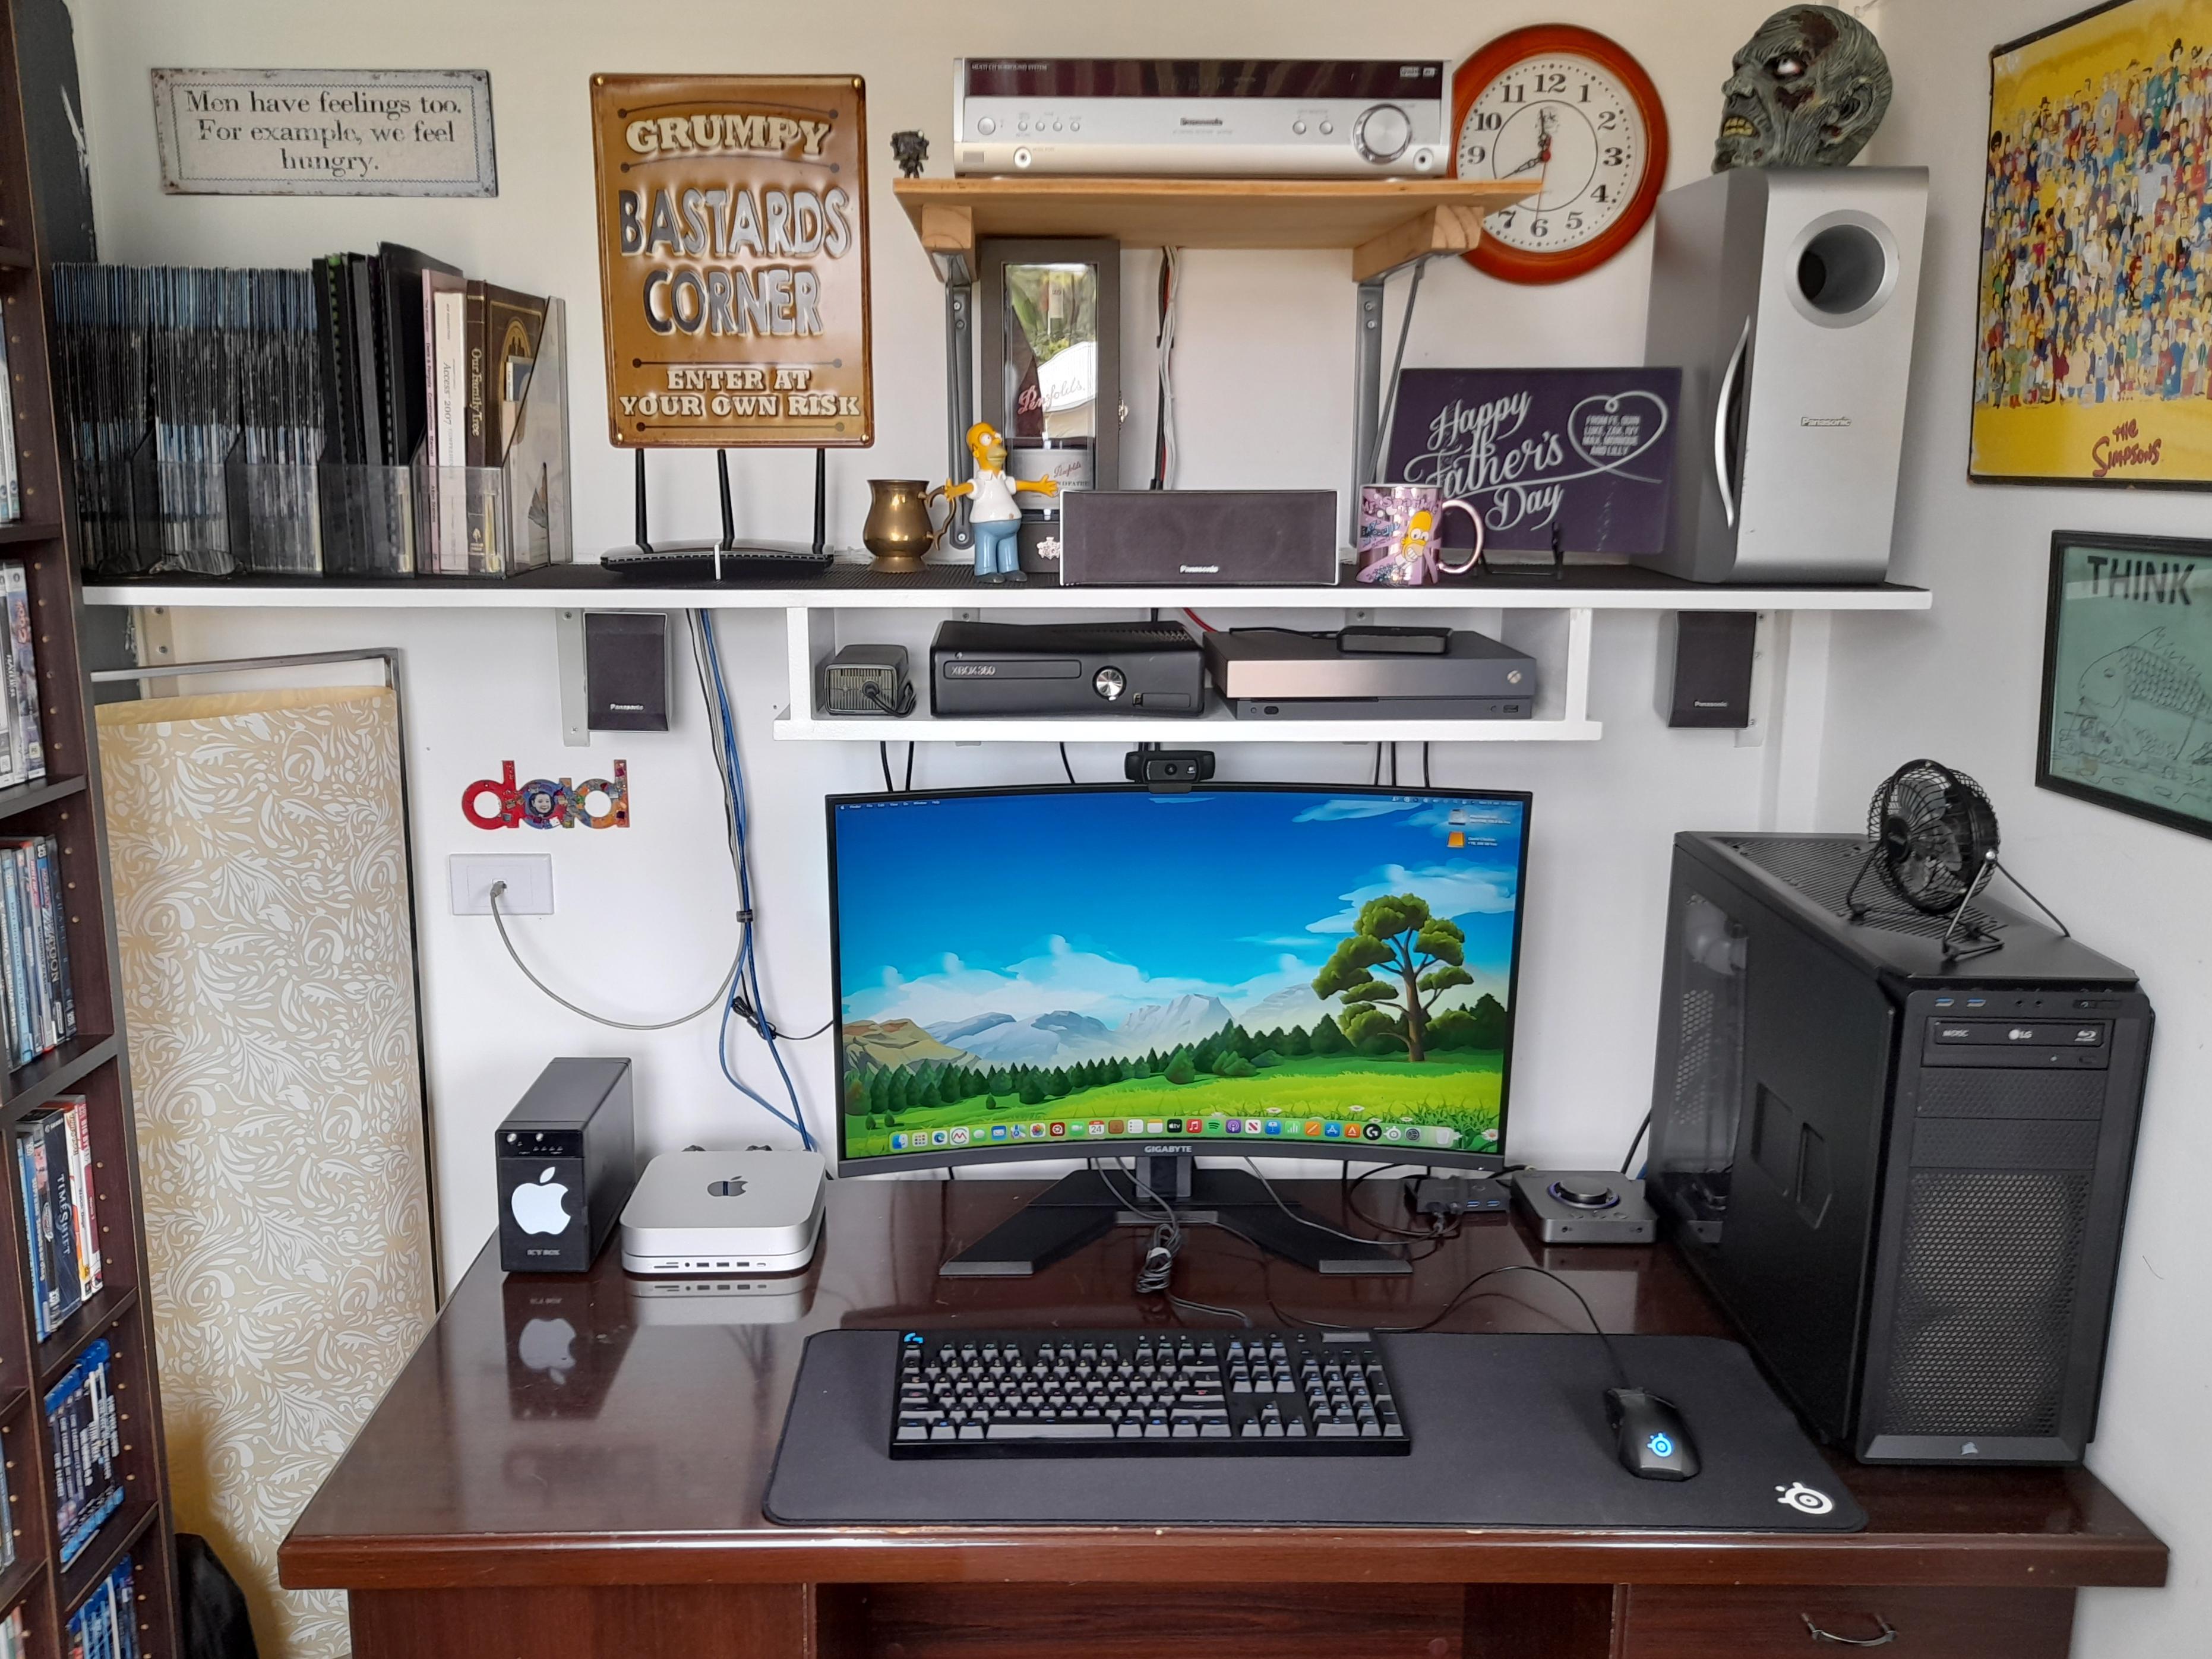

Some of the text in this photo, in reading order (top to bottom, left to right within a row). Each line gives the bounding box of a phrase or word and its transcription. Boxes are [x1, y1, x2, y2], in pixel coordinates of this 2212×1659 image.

[1501, 84, 1527, 103] 11
[1534, 74, 1567, 93] 12
[1579, 84, 1591, 103] 1
[185, 90, 462, 121] Men have feelings too.
[1474, 112, 1502, 131] 10
[1597, 111, 1617, 131] 2
[197, 119, 455, 148] For example, we feel
[625, 114, 832, 156] GRUMPY
[280, 148, 380, 177] hungry.
[1467, 146, 1485, 165] 9
[1604, 147, 1624, 166] 3
[1590, 184, 1609, 203] 4
[618, 188, 852, 258] BASTARDS
[1498, 210, 1516, 229] 7
[1531, 218, 1549, 238] 6
[1565, 211, 1584, 230] 5
[643, 268, 824, 337] CORNER
[666, 368, 811, 390] ENTER AT
[469, 348, 483, 437] Our Family Tree
[444, 401, 452, 426] 2007
[619, 395, 861, 418] YOUR OWN RISK
[1427, 391, 1532, 451] Happy
[1801, 416, 1851, 426] Panasonic
[1404, 429, 1565, 499] Father's
[1485, 484, 1565, 530] Day
[1180, 565, 1219, 574] Panasonic
[2087, 555, 2196, 605] THINK
[462, 759, 630, 830] dad
[37, 926, 47, 966] MONOPOLY
[5, 963, 15, 1004] Wheels
[2020, 1031, 2032, 1039] LG
[1091, 1125, 1102, 1133] 24
